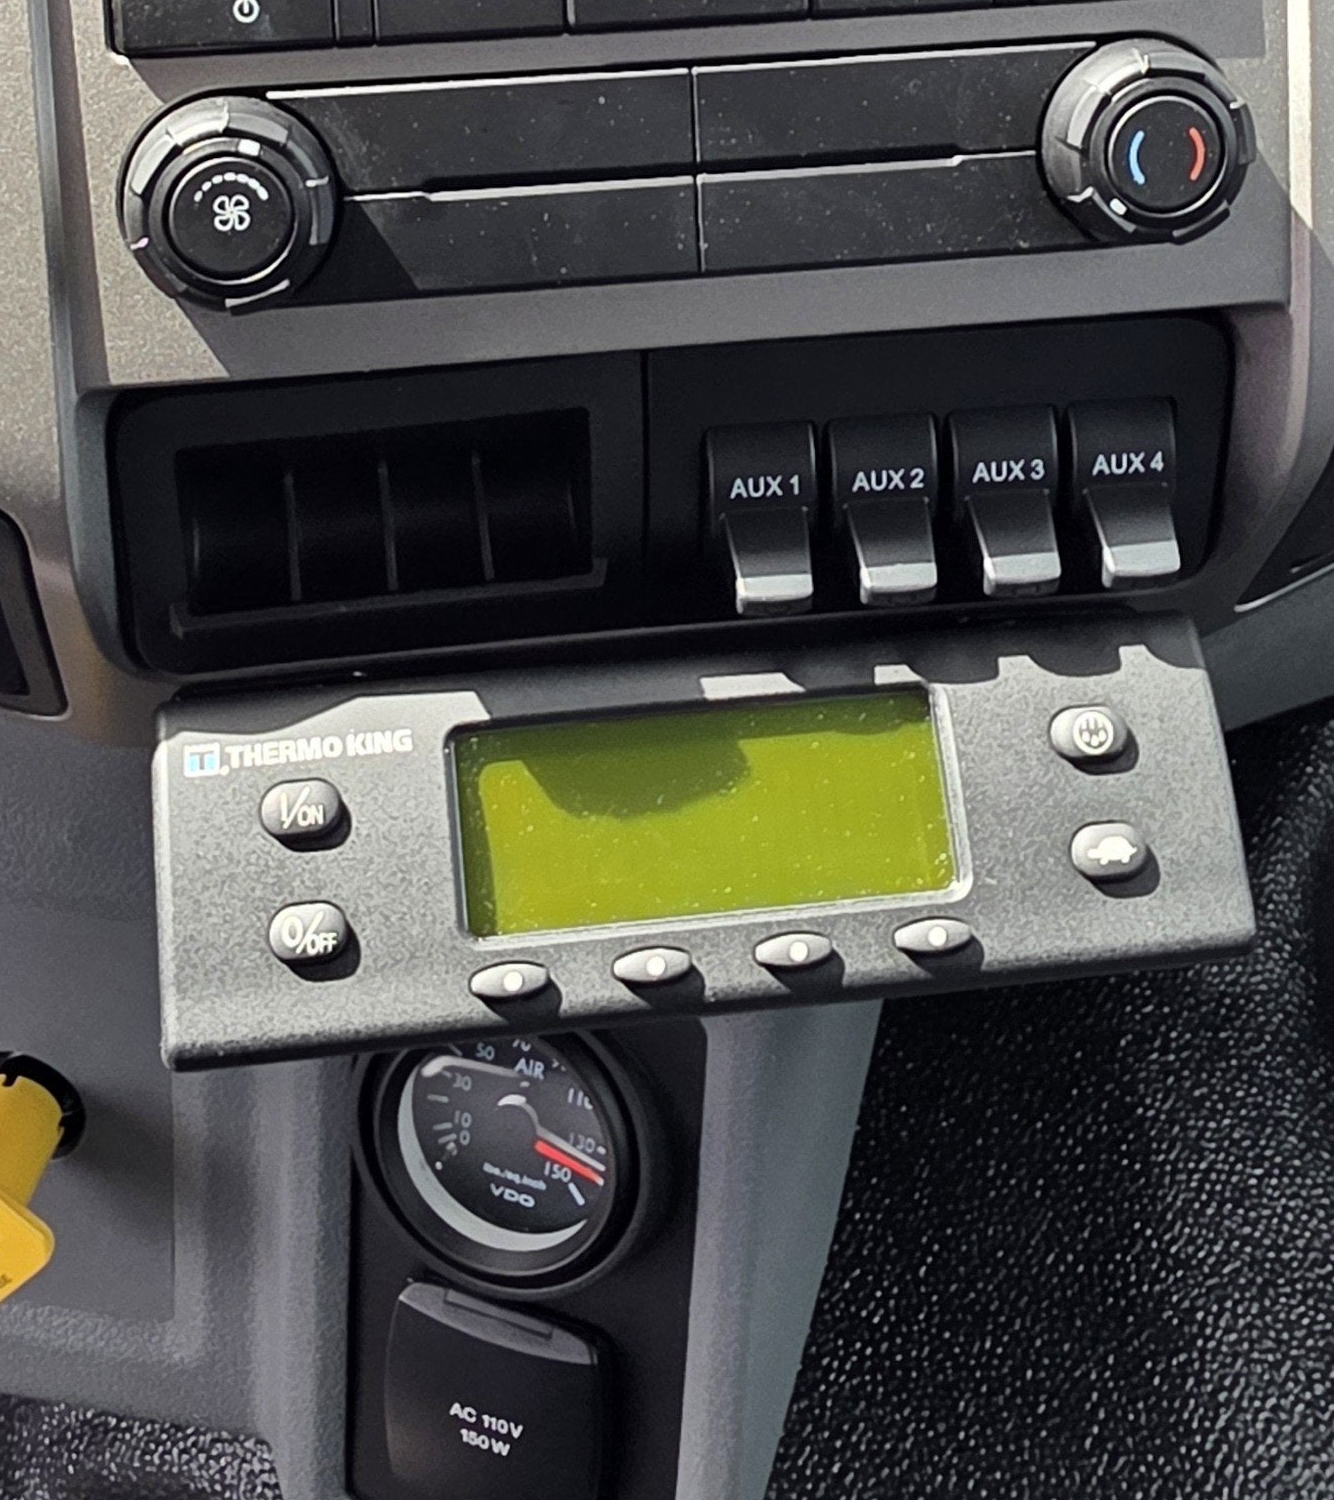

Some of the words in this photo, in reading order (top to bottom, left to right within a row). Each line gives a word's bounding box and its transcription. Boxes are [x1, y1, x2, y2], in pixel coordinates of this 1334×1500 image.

[971, 461, 1025, 484] AUX
[1029, 459, 1046, 481] 3
[1091, 454, 1145, 477] AUX
[1148, 452, 1165, 472] 4
[729, 476, 784, 500] AUX
[789, 475, 801, 496] 1
[851, 470, 906, 493] AUX
[909, 468, 925, 490] 2
[224, 735, 343, 769] THERMO
[345, 729, 414, 757] KING
[475, 1041, 496, 1061] 50
[515, 1057, 545, 1081] AIR
[454, 1110, 473, 1129] 10
[569, 1132, 596, 1154] 130
[543, 1160, 572, 1183] 150
[489, 1182, 536, 1208] VDO
[448, 1401, 478, 1424] AC
